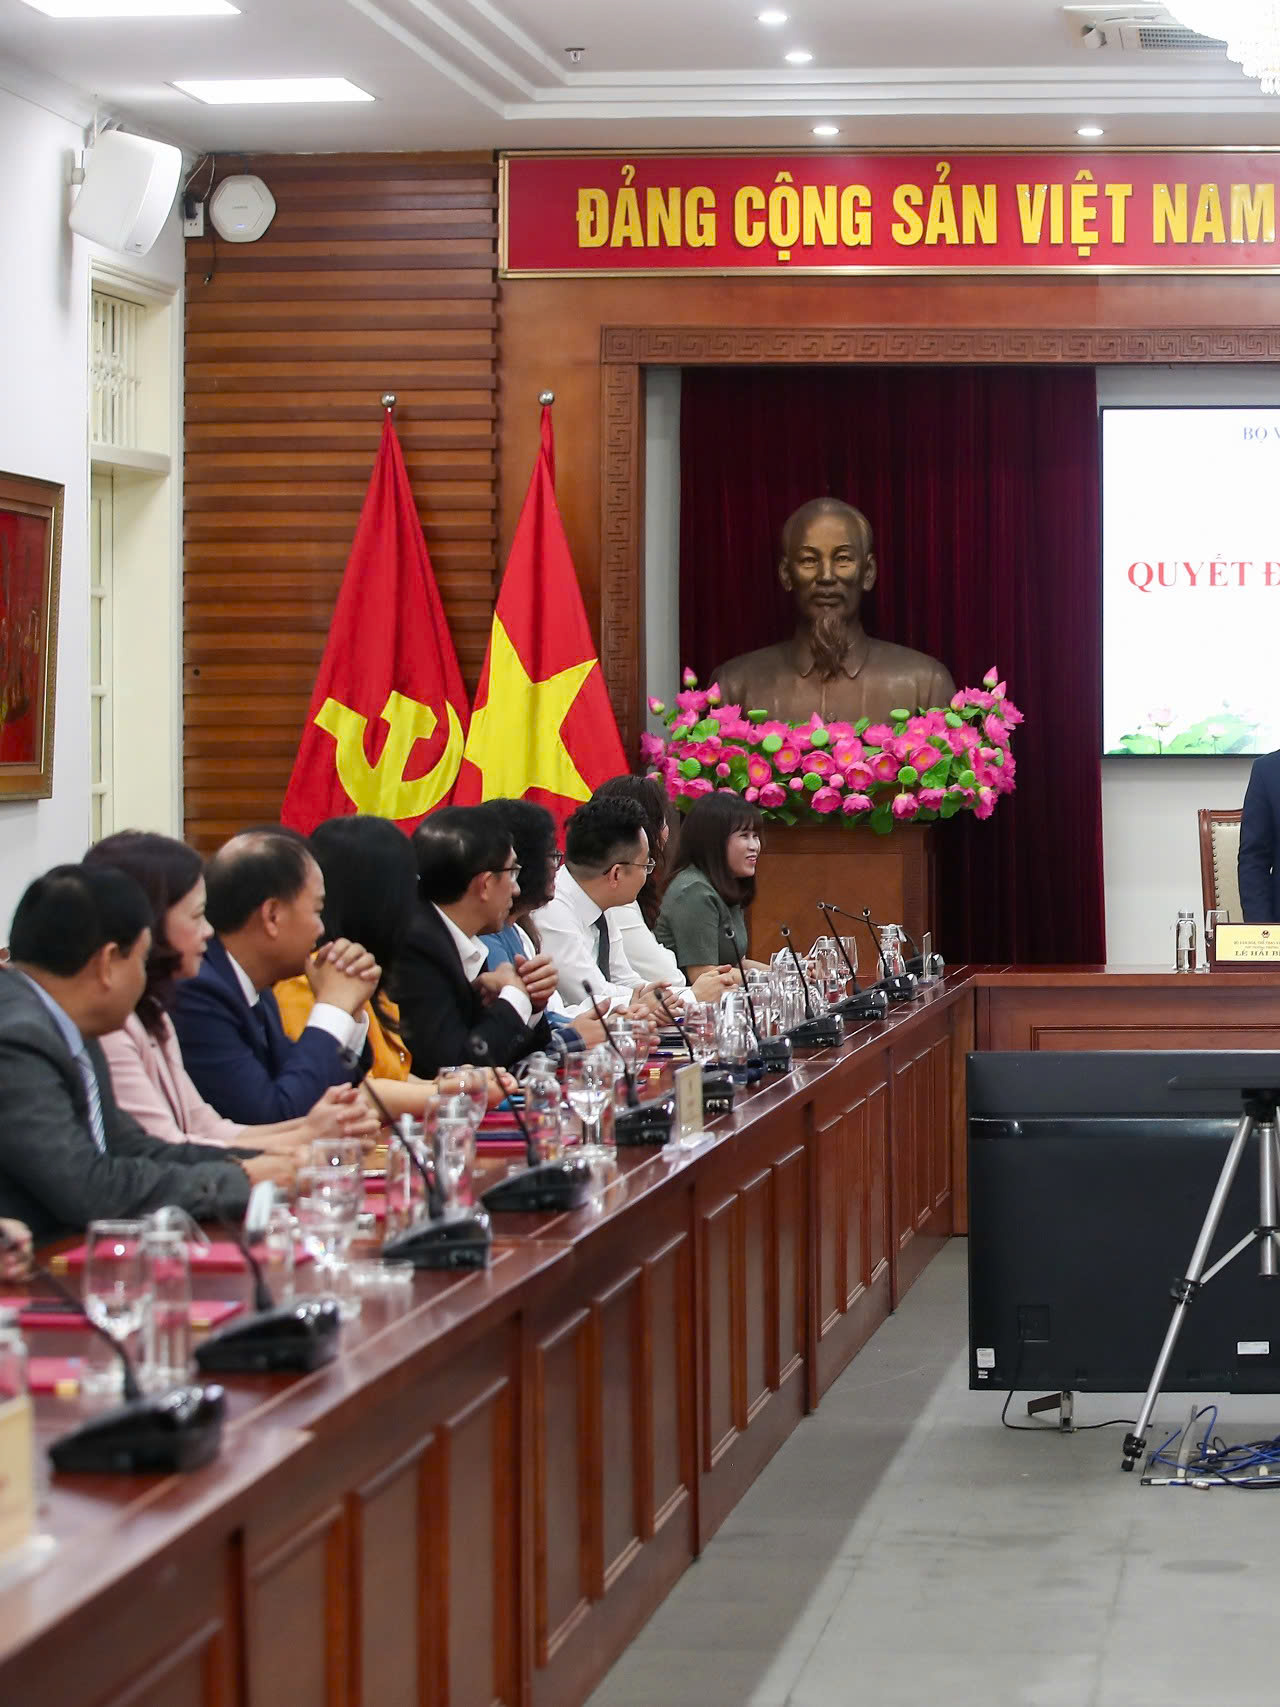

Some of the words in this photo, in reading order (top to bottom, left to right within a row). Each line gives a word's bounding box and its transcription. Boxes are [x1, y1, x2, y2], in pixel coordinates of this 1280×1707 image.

[577, 164, 716, 247] ĐẢNG
[733, 171, 872, 261] CỘNG
[891, 161, 997, 245] SẢN
[1016, 169, 1133, 256] VIỆT
[1153, 183, 1274, 244] NAM
[1127, 553, 1254, 593] QUYẾT
